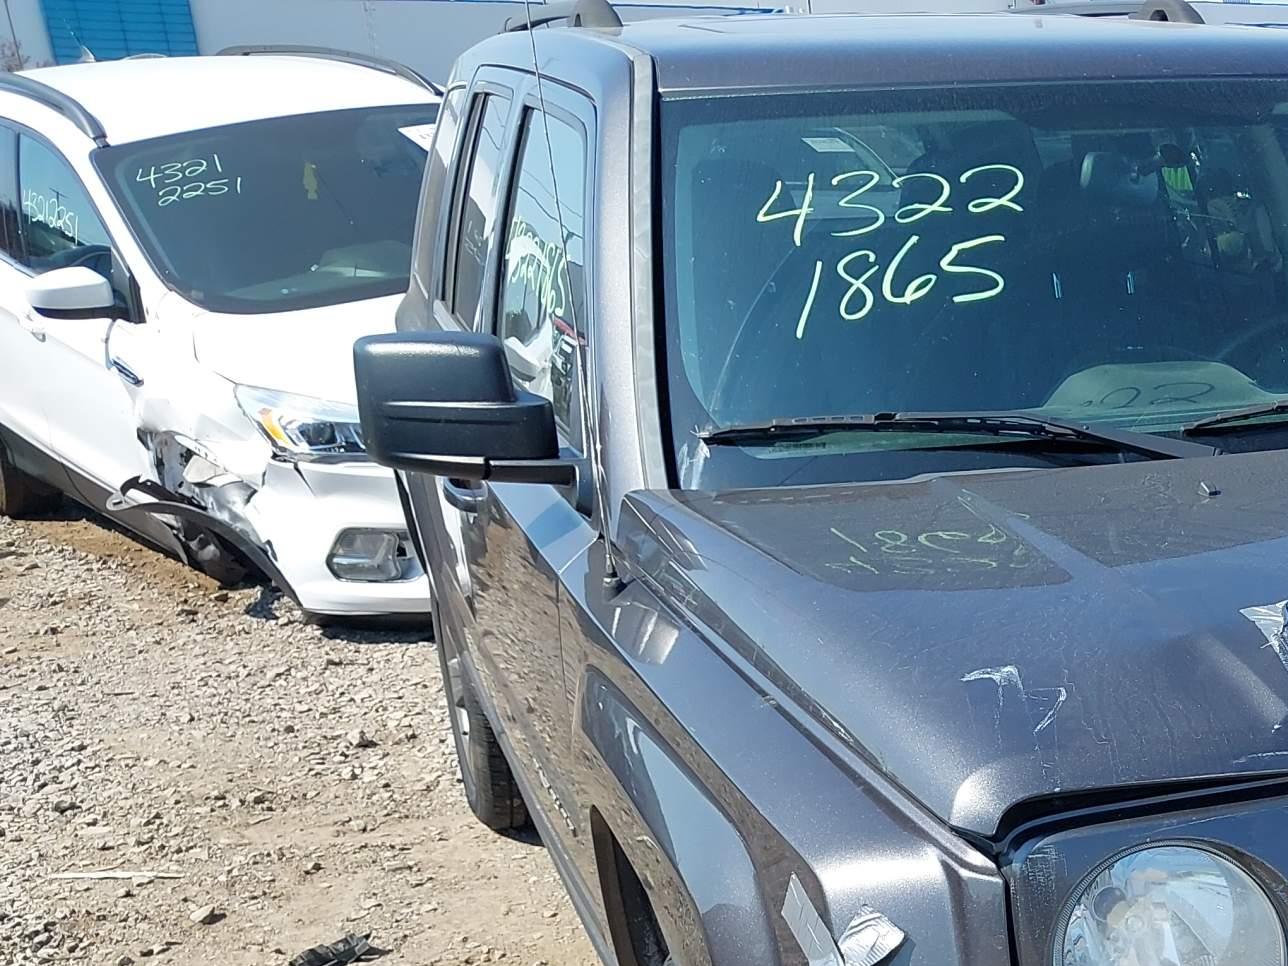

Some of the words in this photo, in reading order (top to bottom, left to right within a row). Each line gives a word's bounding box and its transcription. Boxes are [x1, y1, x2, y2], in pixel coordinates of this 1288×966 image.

[135, 153, 223, 188] 4321
[157, 177, 241, 207] 2251
[22, 189, 79, 246] 43212251
[756, 164, 1024, 247] 4322
[796, 235, 1006, 338] 1865
